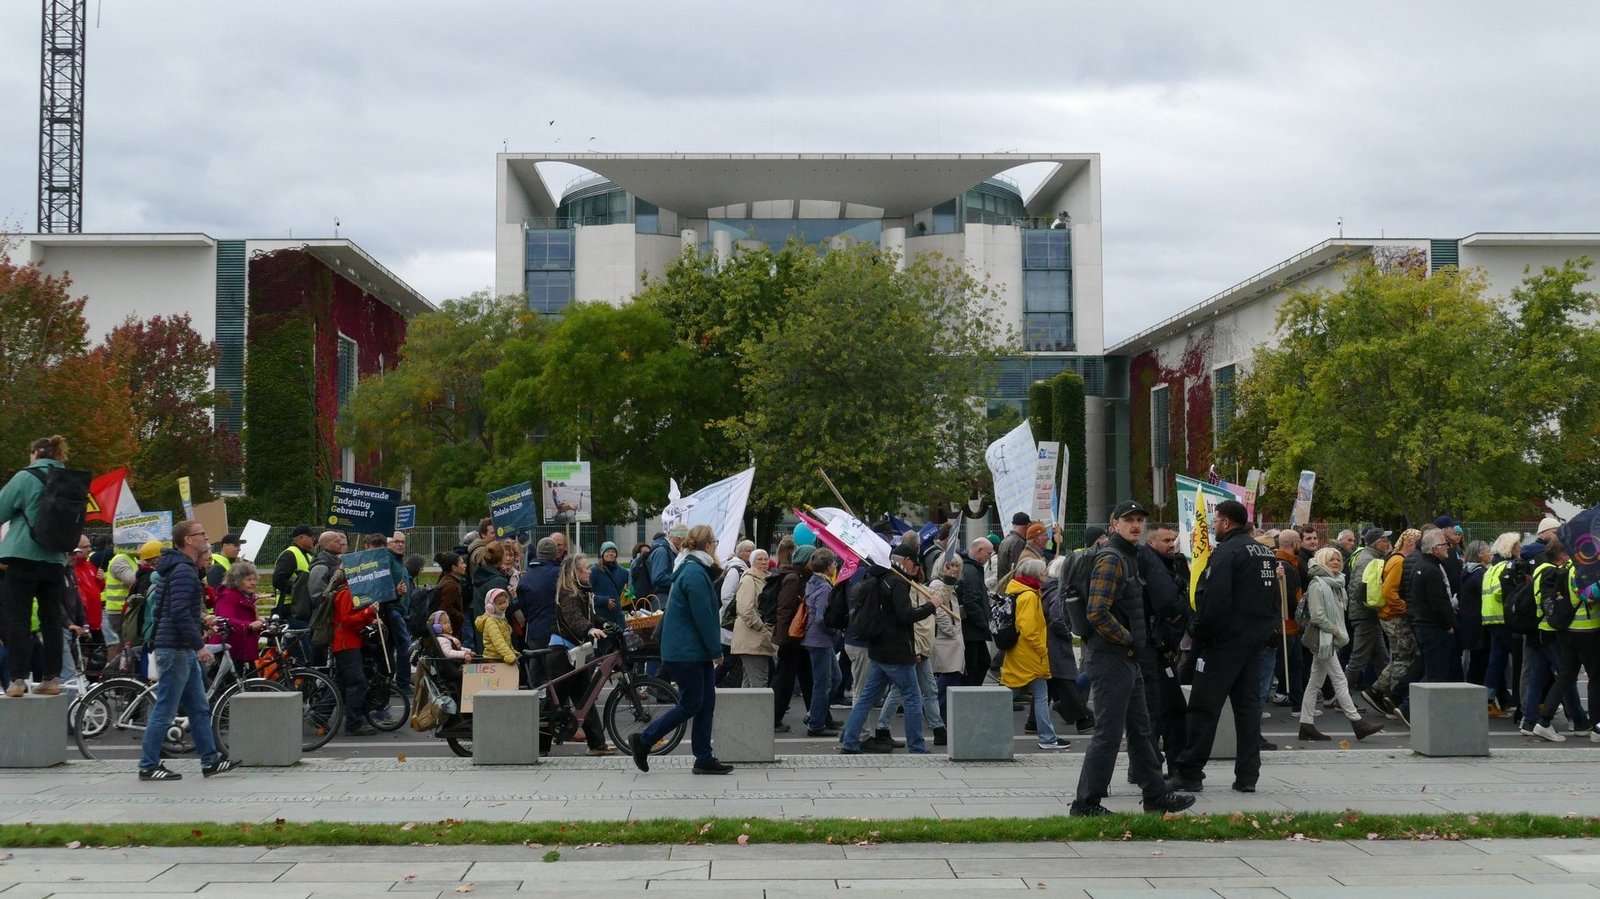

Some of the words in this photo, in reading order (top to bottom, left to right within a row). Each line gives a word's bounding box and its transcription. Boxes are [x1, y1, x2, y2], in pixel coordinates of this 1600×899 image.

[334, 484, 390, 500] Energiewende
[332, 495, 371, 509] Endgültig
[331, 505, 368, 517] Gebremst
[369, 510, 375, 519] ?
[1262, 560, 1271, 569] BE
